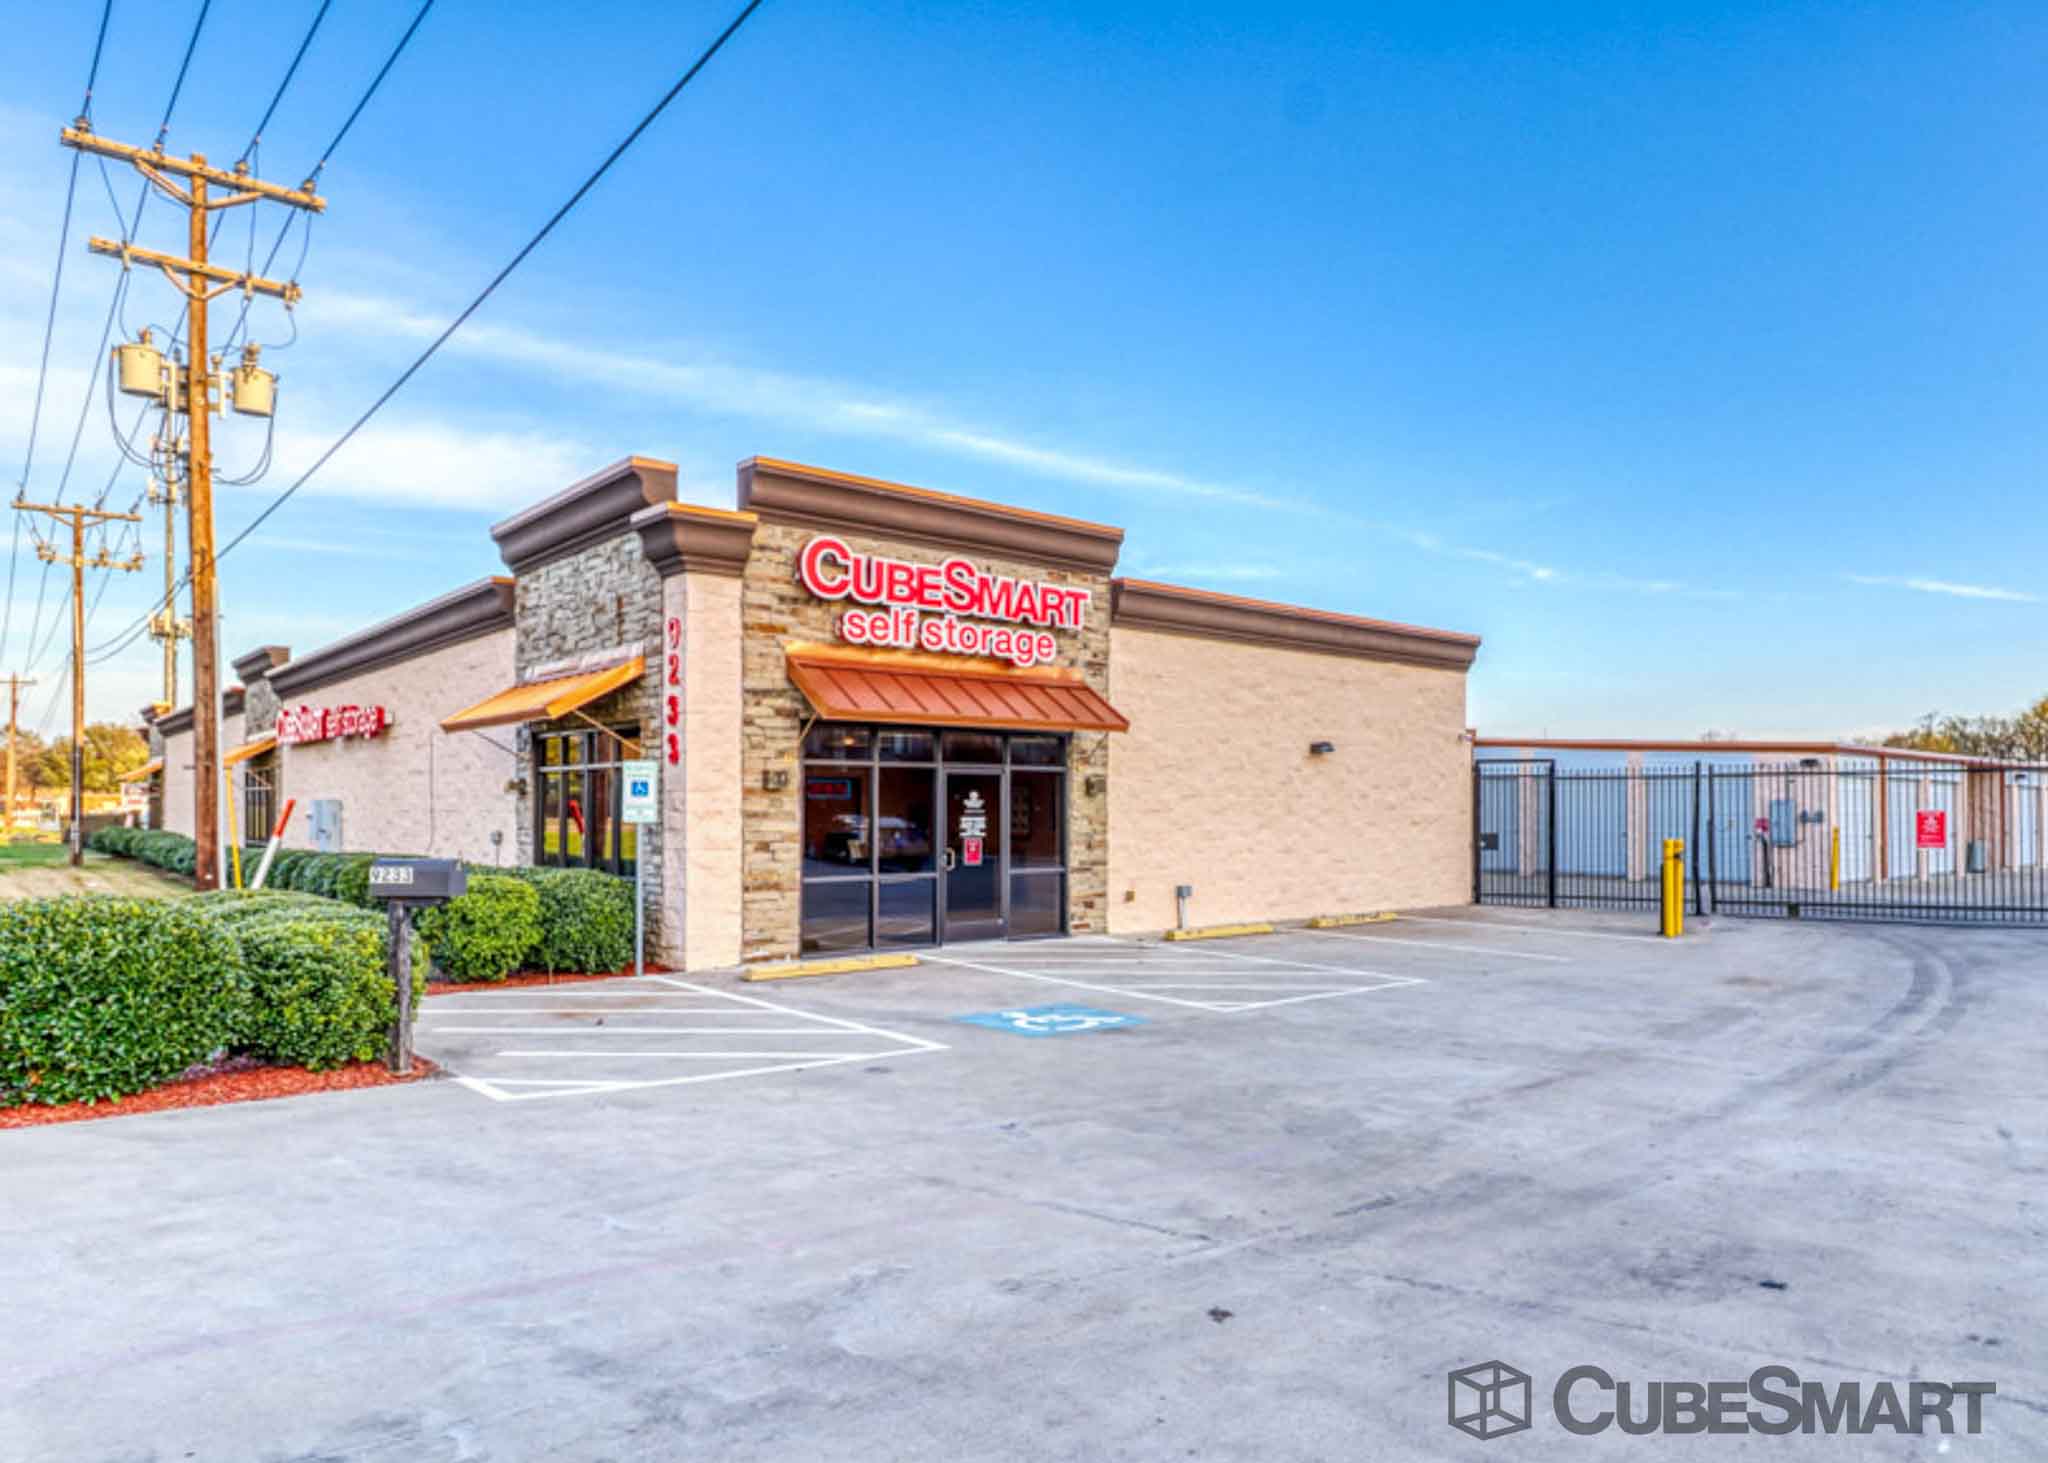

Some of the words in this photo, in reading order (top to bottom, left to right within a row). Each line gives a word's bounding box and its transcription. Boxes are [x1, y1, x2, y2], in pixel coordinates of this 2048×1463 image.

[800, 536, 1091, 629] CUBESMART
[842, 608, 918, 647] self
[921, 614, 1057, 667] storage
